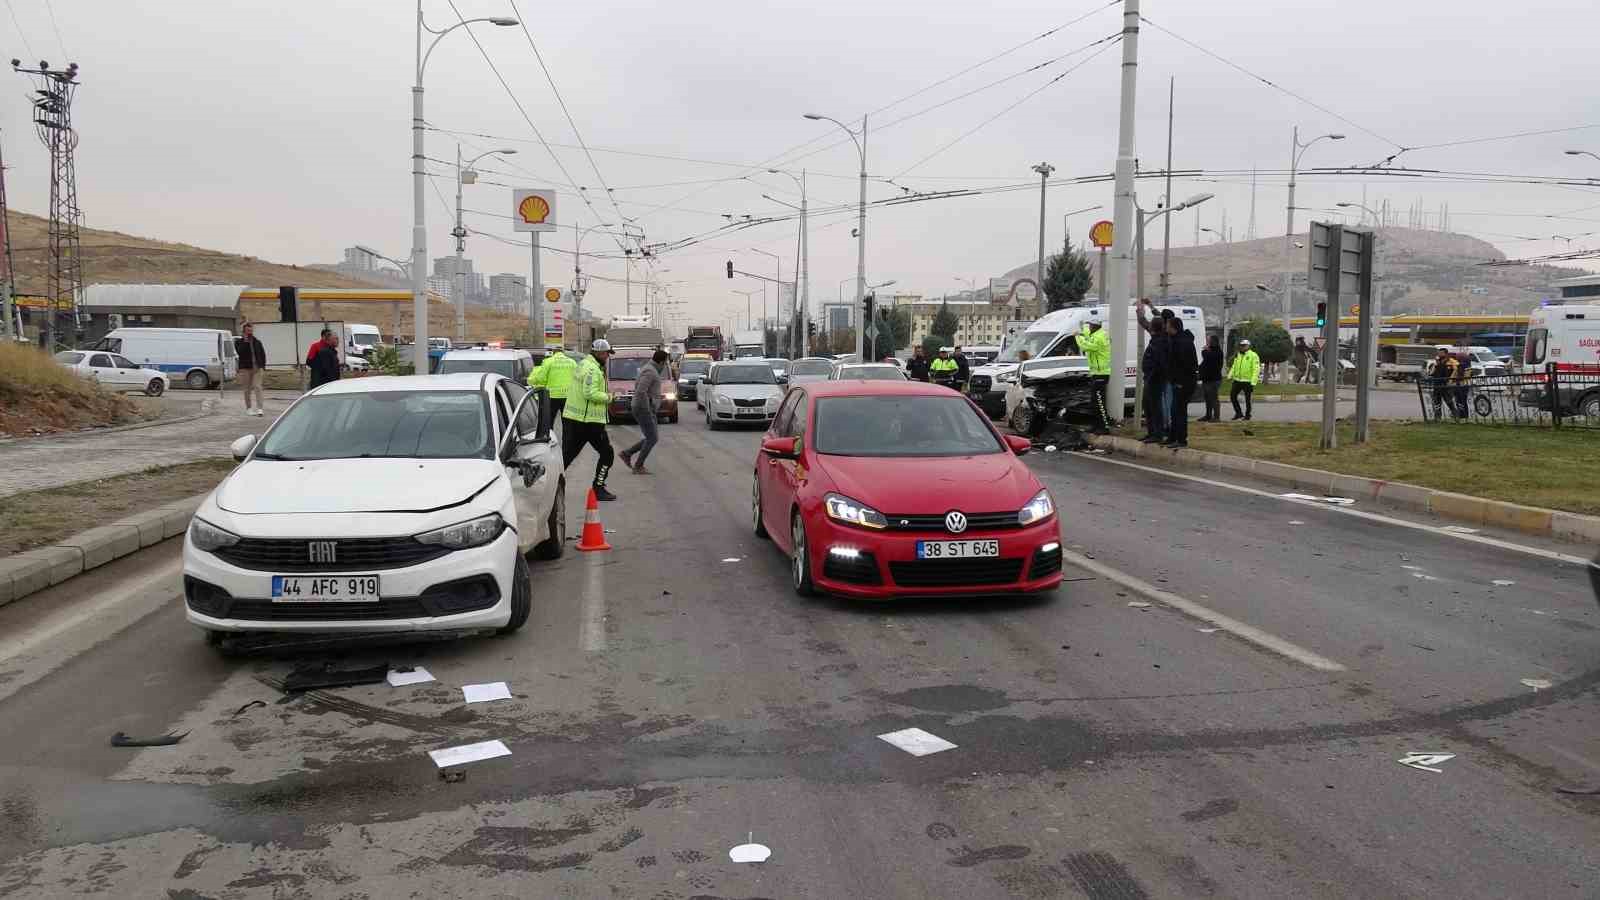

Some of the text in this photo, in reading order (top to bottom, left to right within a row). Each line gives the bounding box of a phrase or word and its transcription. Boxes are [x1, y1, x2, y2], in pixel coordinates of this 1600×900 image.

[308, 541, 338, 563] FIAT
[926, 541, 998, 557] 38 ST 645
[283, 579, 376, 595] 44 AFC 919
